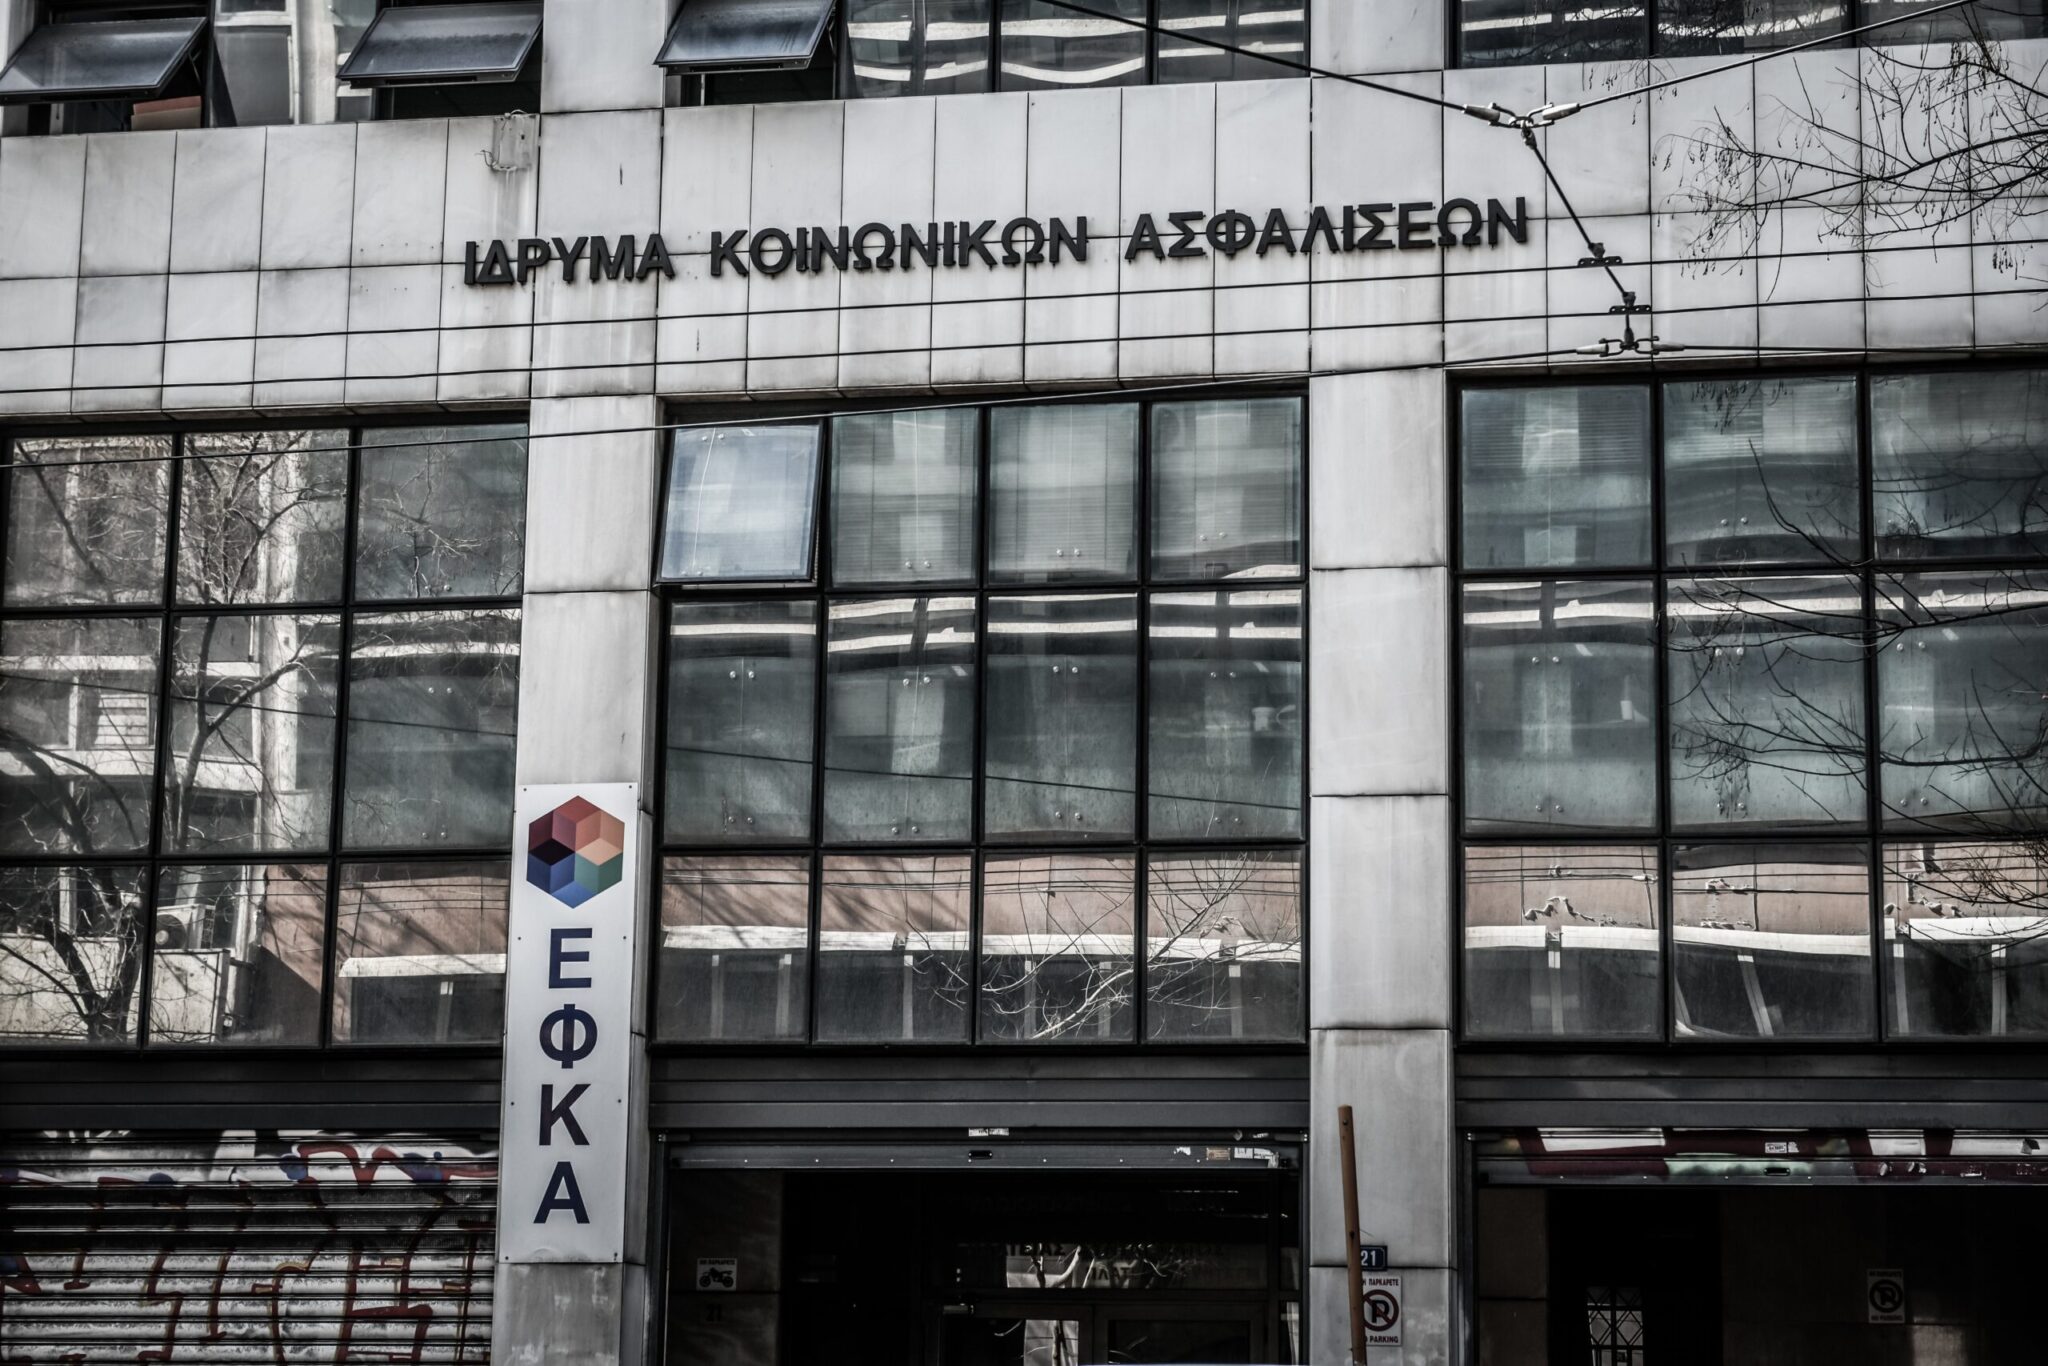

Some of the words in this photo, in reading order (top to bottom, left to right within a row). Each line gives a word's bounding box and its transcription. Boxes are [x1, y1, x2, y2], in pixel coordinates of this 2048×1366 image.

[464, 233, 676, 285] ΙΔΡΥΜΑ
[709, 215, 1087, 277] ΚΟΙΝΩΝΙΚΩΝ
[1124, 196, 1527, 260] ΑΣΦΑΛΙΣΕΩΝ
[533, 927, 598, 1224] ΕΦΚΑ
[1360, 1250, 1376, 1266] 21
[1369, 1335, 1399, 1344] PARKING
